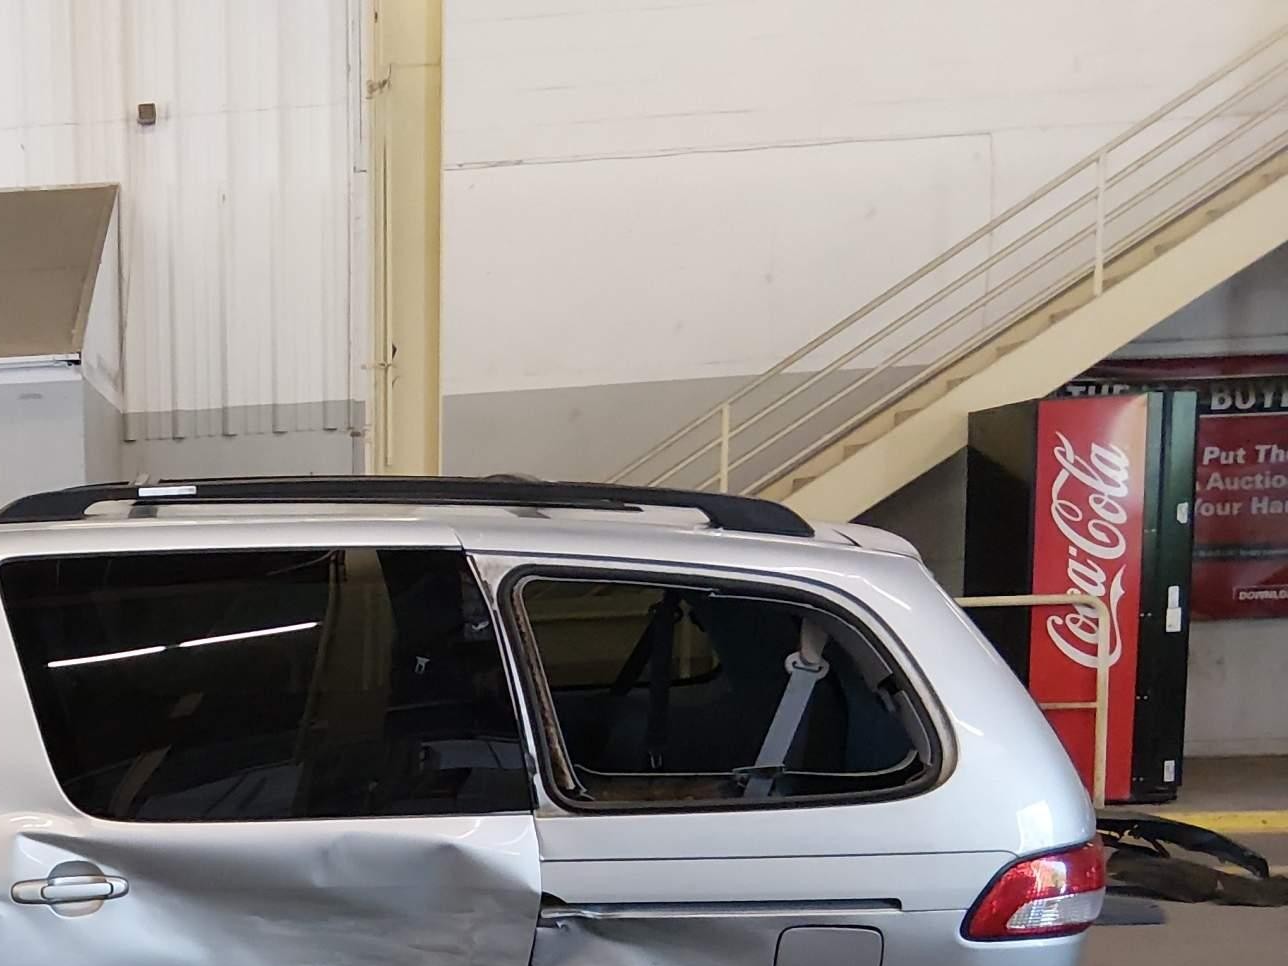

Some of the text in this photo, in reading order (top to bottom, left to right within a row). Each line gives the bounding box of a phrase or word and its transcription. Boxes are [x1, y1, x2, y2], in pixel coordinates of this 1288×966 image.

[1203, 444, 1288, 465] Put Th
[1251, 496, 1288, 514] Ha
